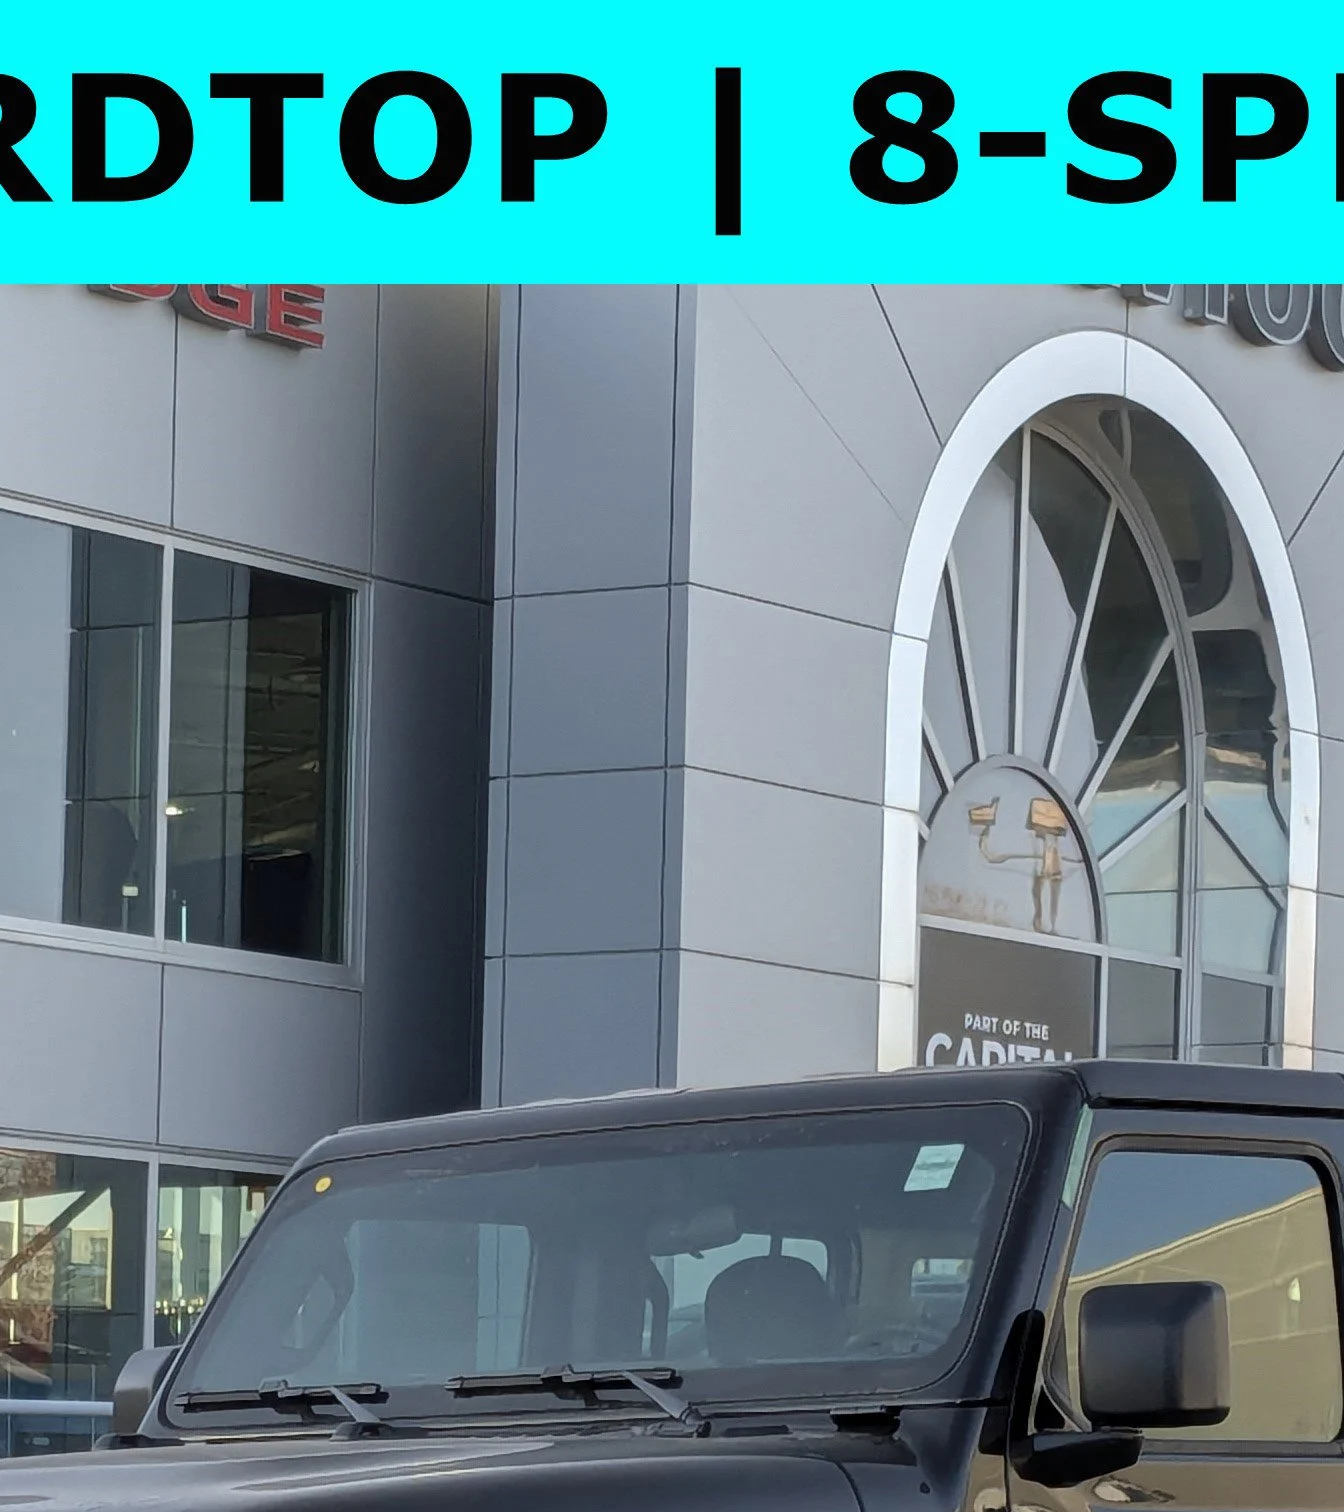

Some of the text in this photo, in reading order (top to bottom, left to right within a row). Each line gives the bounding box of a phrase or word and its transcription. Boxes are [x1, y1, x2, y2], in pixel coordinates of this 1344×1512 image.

[964, 1013, 1049, 1041] PART OF THE
